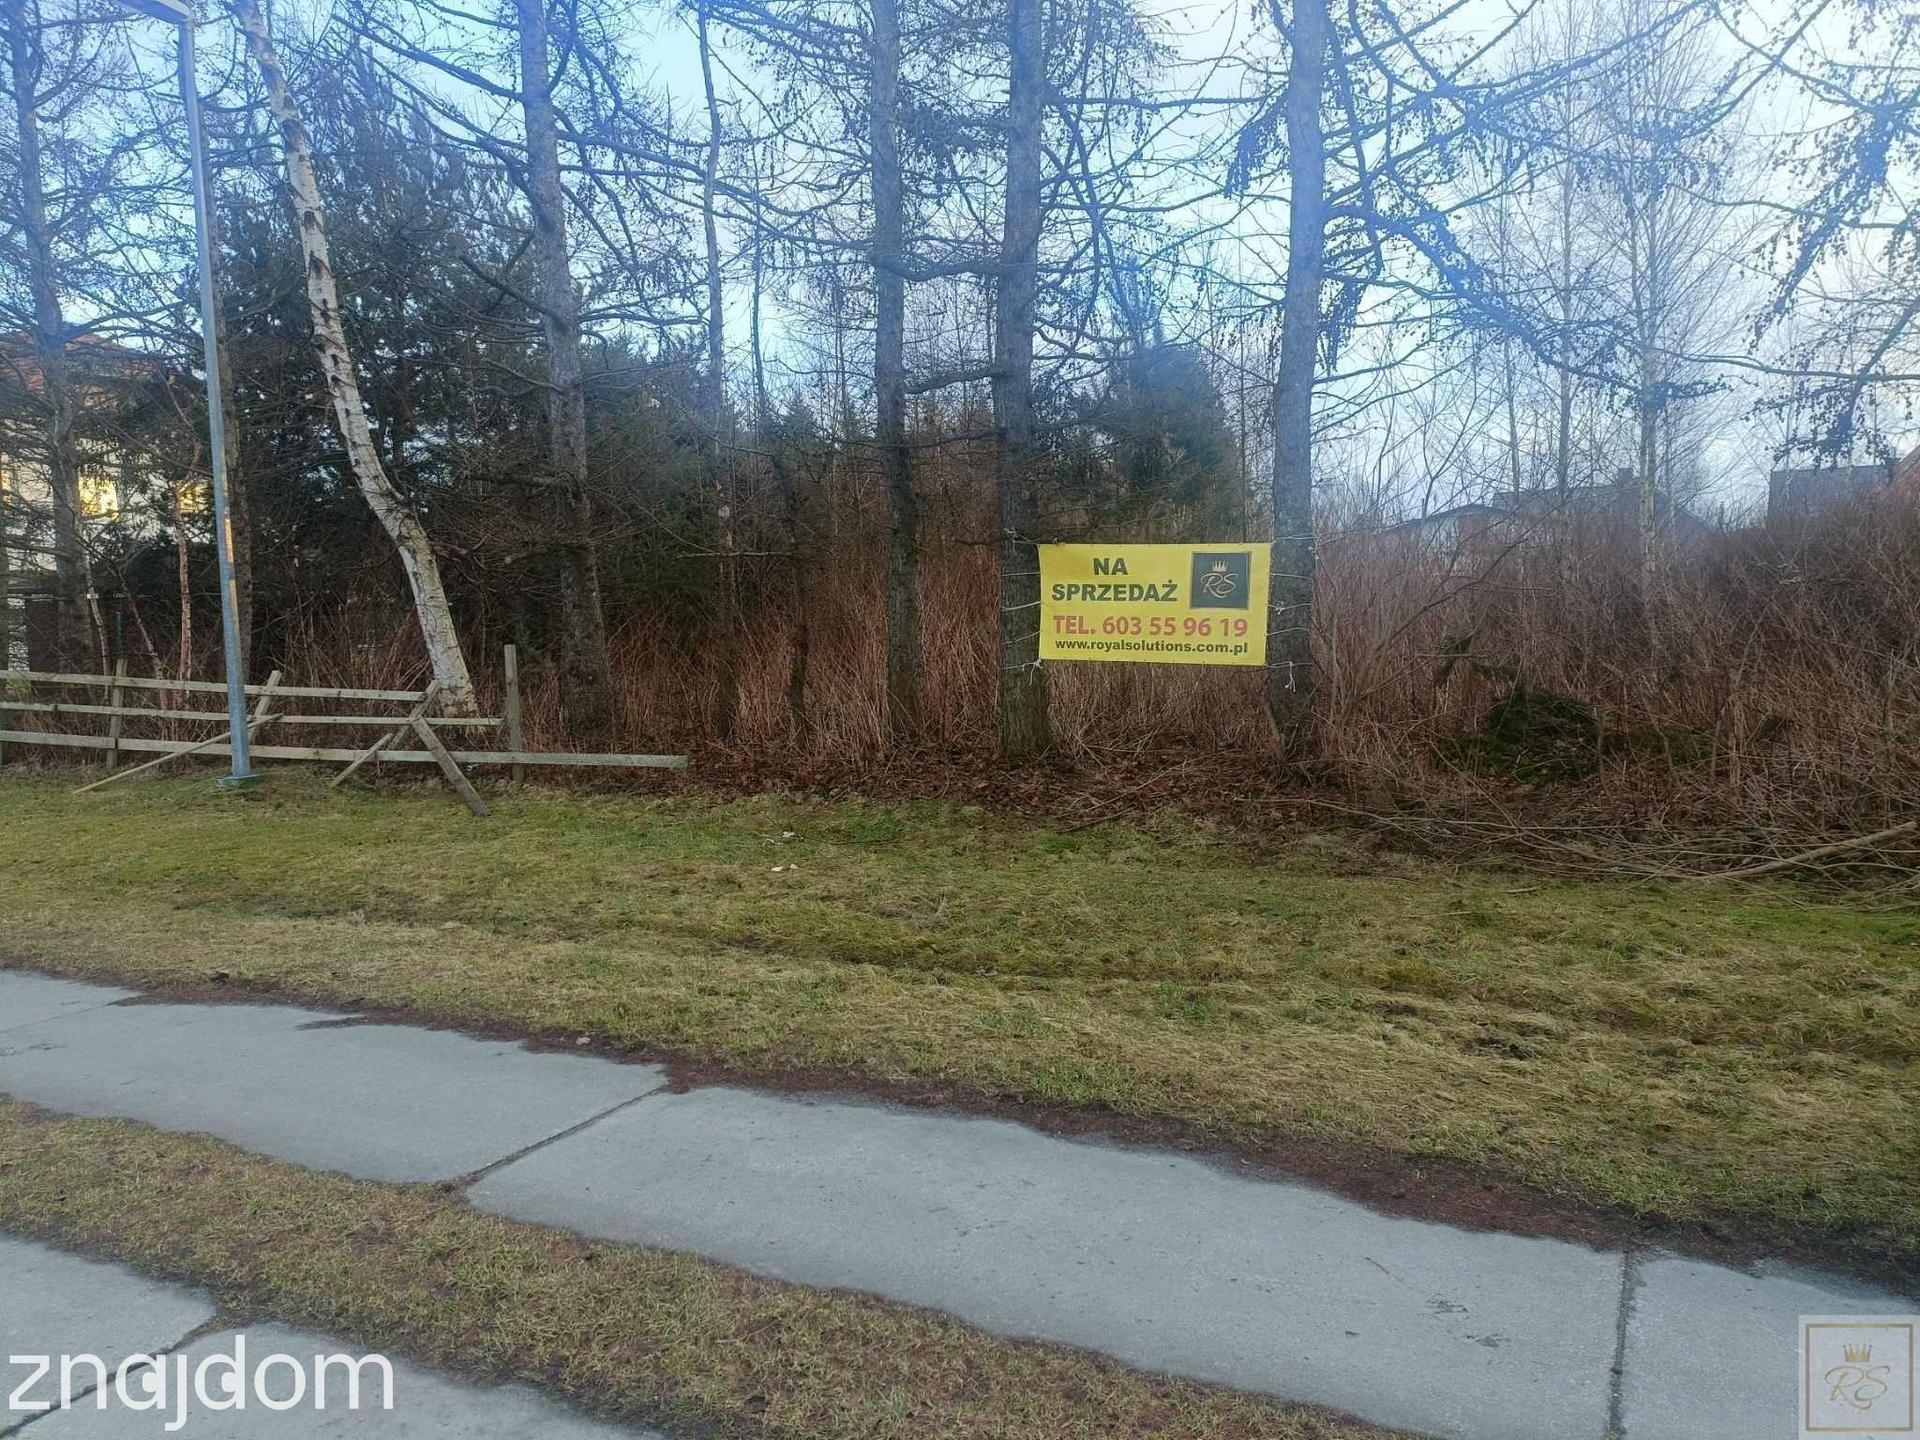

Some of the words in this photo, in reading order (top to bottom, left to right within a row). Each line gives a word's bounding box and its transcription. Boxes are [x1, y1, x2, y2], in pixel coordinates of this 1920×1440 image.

[1093, 557, 1128, 576] NA
[1051, 579, 1178, 602] SPRZEDAŻ
[1053, 615, 1096, 635] TEL.
[1102, 616, 1142, 636] 603
[1149, 617, 1176, 637] 55
[1183, 617, 1212, 637] 96
[1219, 618, 1248, 637] 19
[1055, 639, 1248, 656] www.royalsolutions.com.pl
